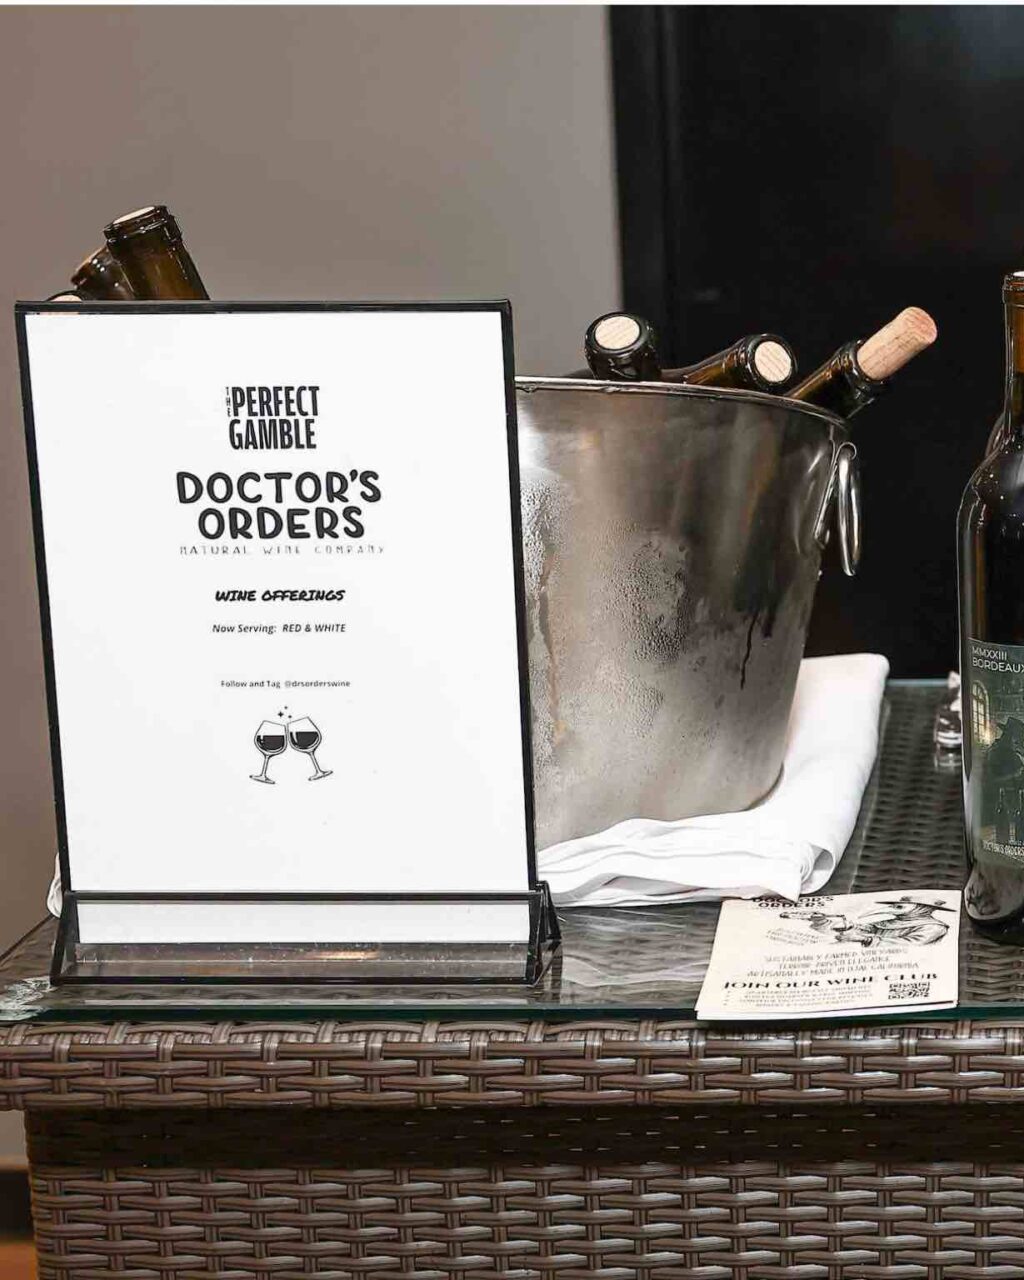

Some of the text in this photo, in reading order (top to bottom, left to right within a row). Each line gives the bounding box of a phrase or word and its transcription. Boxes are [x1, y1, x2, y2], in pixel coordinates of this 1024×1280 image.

[232, 385, 320, 417] PERFECT
[229, 418, 317, 450] GAMBLE
[176, 469, 381, 504] DOCTOR'S
[198, 506, 365, 540] ORDERS
[180, 545, 384, 555] NATURAL WINE COMPANY
[215, 590, 345, 602] WINE OFFERINGS
[212, 624, 346, 635] Now Serving: RED & WHITE
[972, 647, 1007, 660] MMXXIII
[221, 680, 350, 689] Follow and Tag @drsorderswine
[884, 973, 937, 981] CLUB
